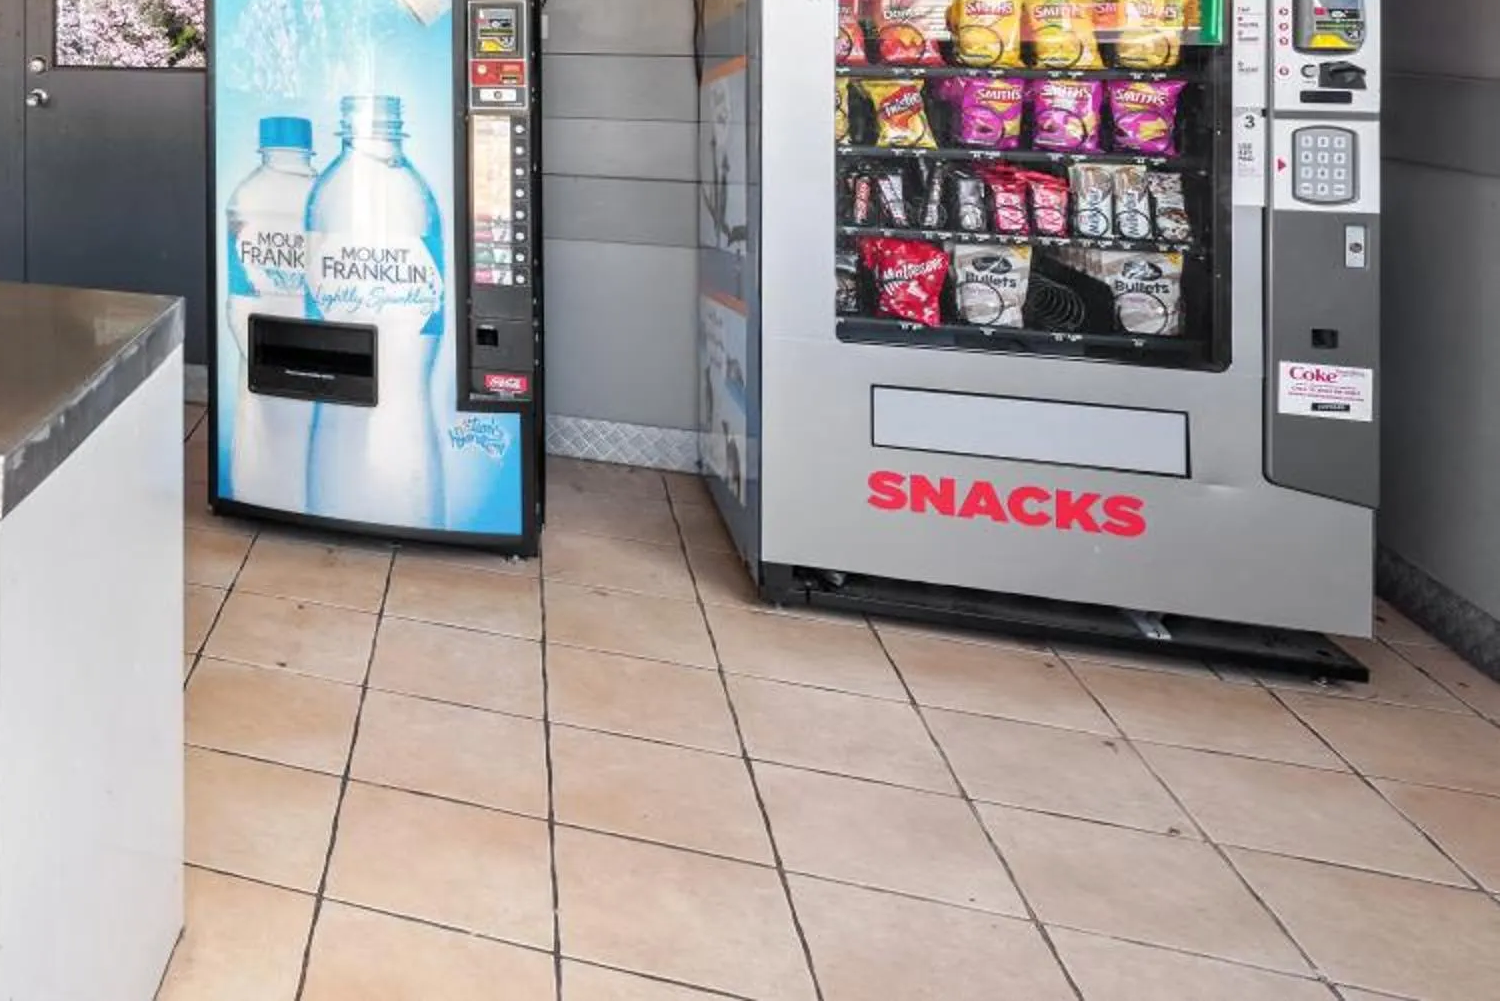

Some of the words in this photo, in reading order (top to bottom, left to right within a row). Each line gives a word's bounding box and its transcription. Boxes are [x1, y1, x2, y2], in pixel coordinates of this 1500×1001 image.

[1244, 114, 1256, 129] 3
[341, 246, 410, 263] MOUNT
[322, 256, 427, 284] FRANKLIN
[965, 272, 1017, 288] Bullets
[1114, 279, 1171, 294] Bullets
[1289, 366, 1338, 383] Coke
[866, 470, 1148, 539] SNACKS
